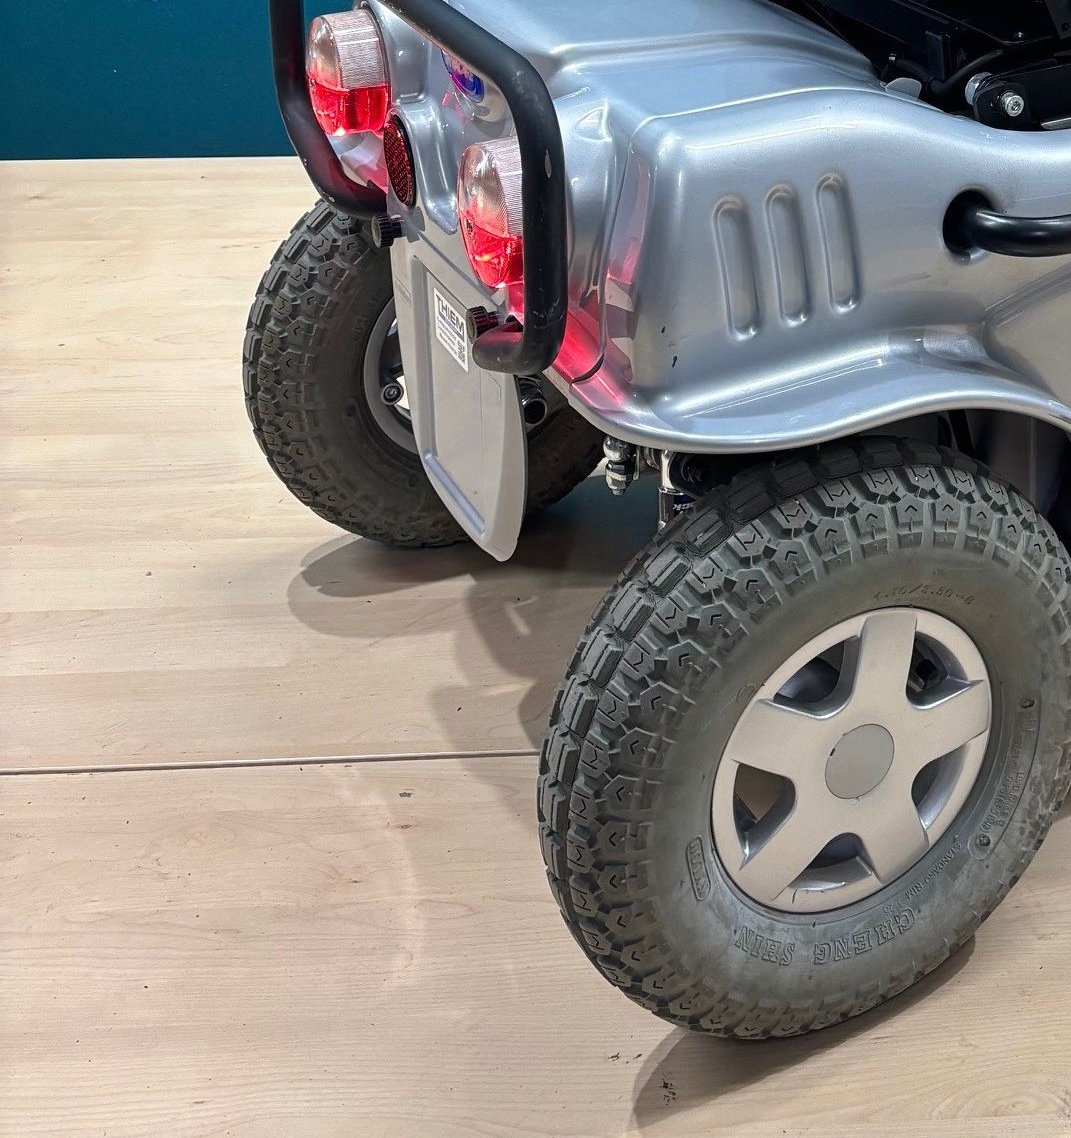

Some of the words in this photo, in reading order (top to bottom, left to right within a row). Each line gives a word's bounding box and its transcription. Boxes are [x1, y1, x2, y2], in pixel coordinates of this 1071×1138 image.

[436, 293, 466, 340] THIEM
[734, 925, 797, 967] SHIN
[813, 906, 916, 966] CHENG
